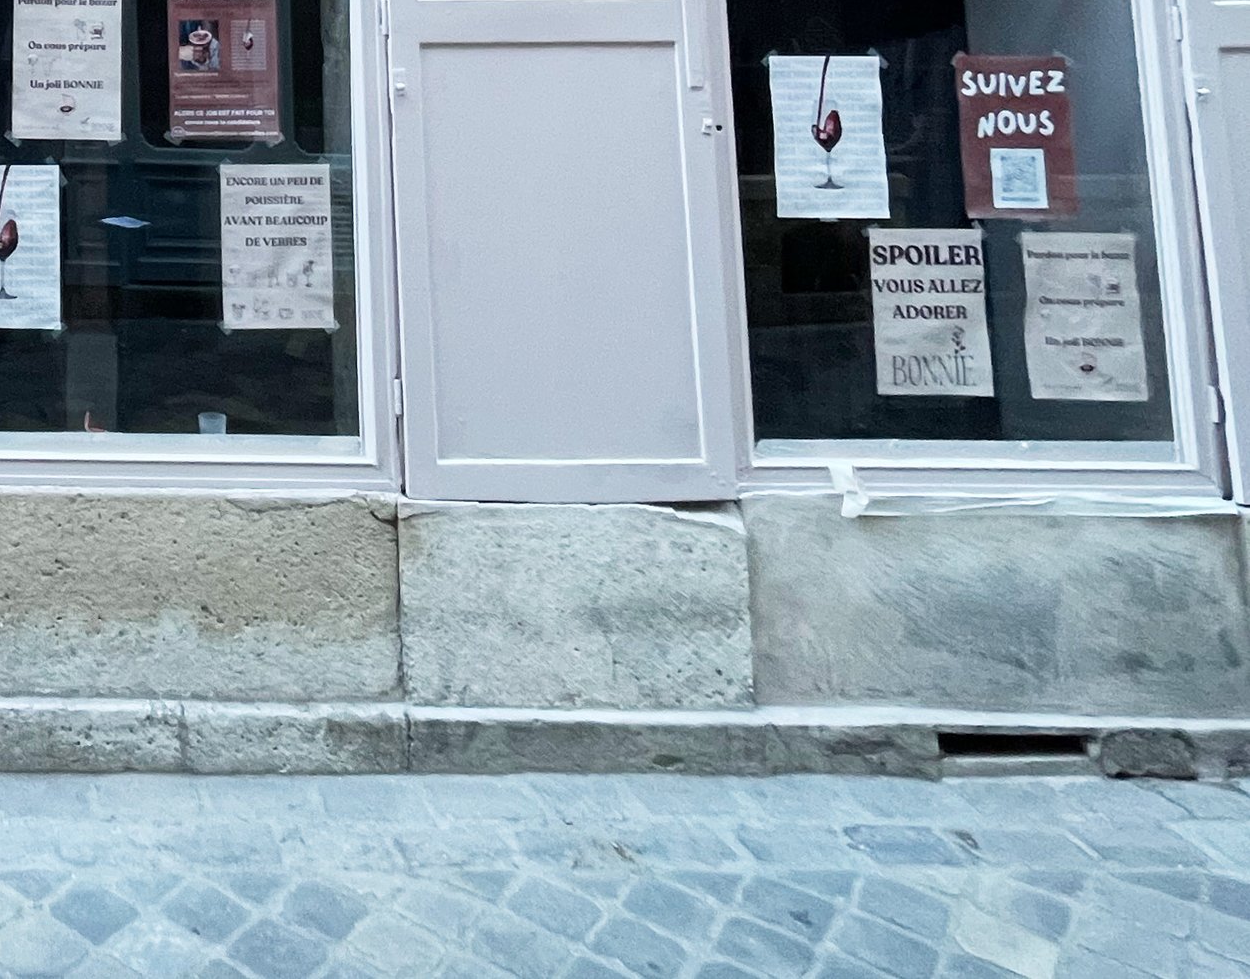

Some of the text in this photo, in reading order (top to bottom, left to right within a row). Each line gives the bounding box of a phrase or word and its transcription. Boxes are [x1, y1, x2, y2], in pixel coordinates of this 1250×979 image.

[28, 41, 42, 50] On
[68, 42, 106, 52] prépare
[30, 80, 104, 90] Un joli BONNIE
[960, 70, 1065, 97] SUIVEZ
[977, 109, 1055, 139] NOUS
[226, 176, 324, 187] ENCORE UN PEU DE
[245, 194, 304, 205] POUSSIÈRE
[224, 215, 328, 226] AVANT BEAUCOUP
[245, 237, 308, 247] DE VERRES
[872, 244, 982, 267] SPOILER
[873, 279, 983, 294] VOUS ALLEZ
[893, 304, 968, 320] ADORER
[891, 354, 977, 387] BONNIE
